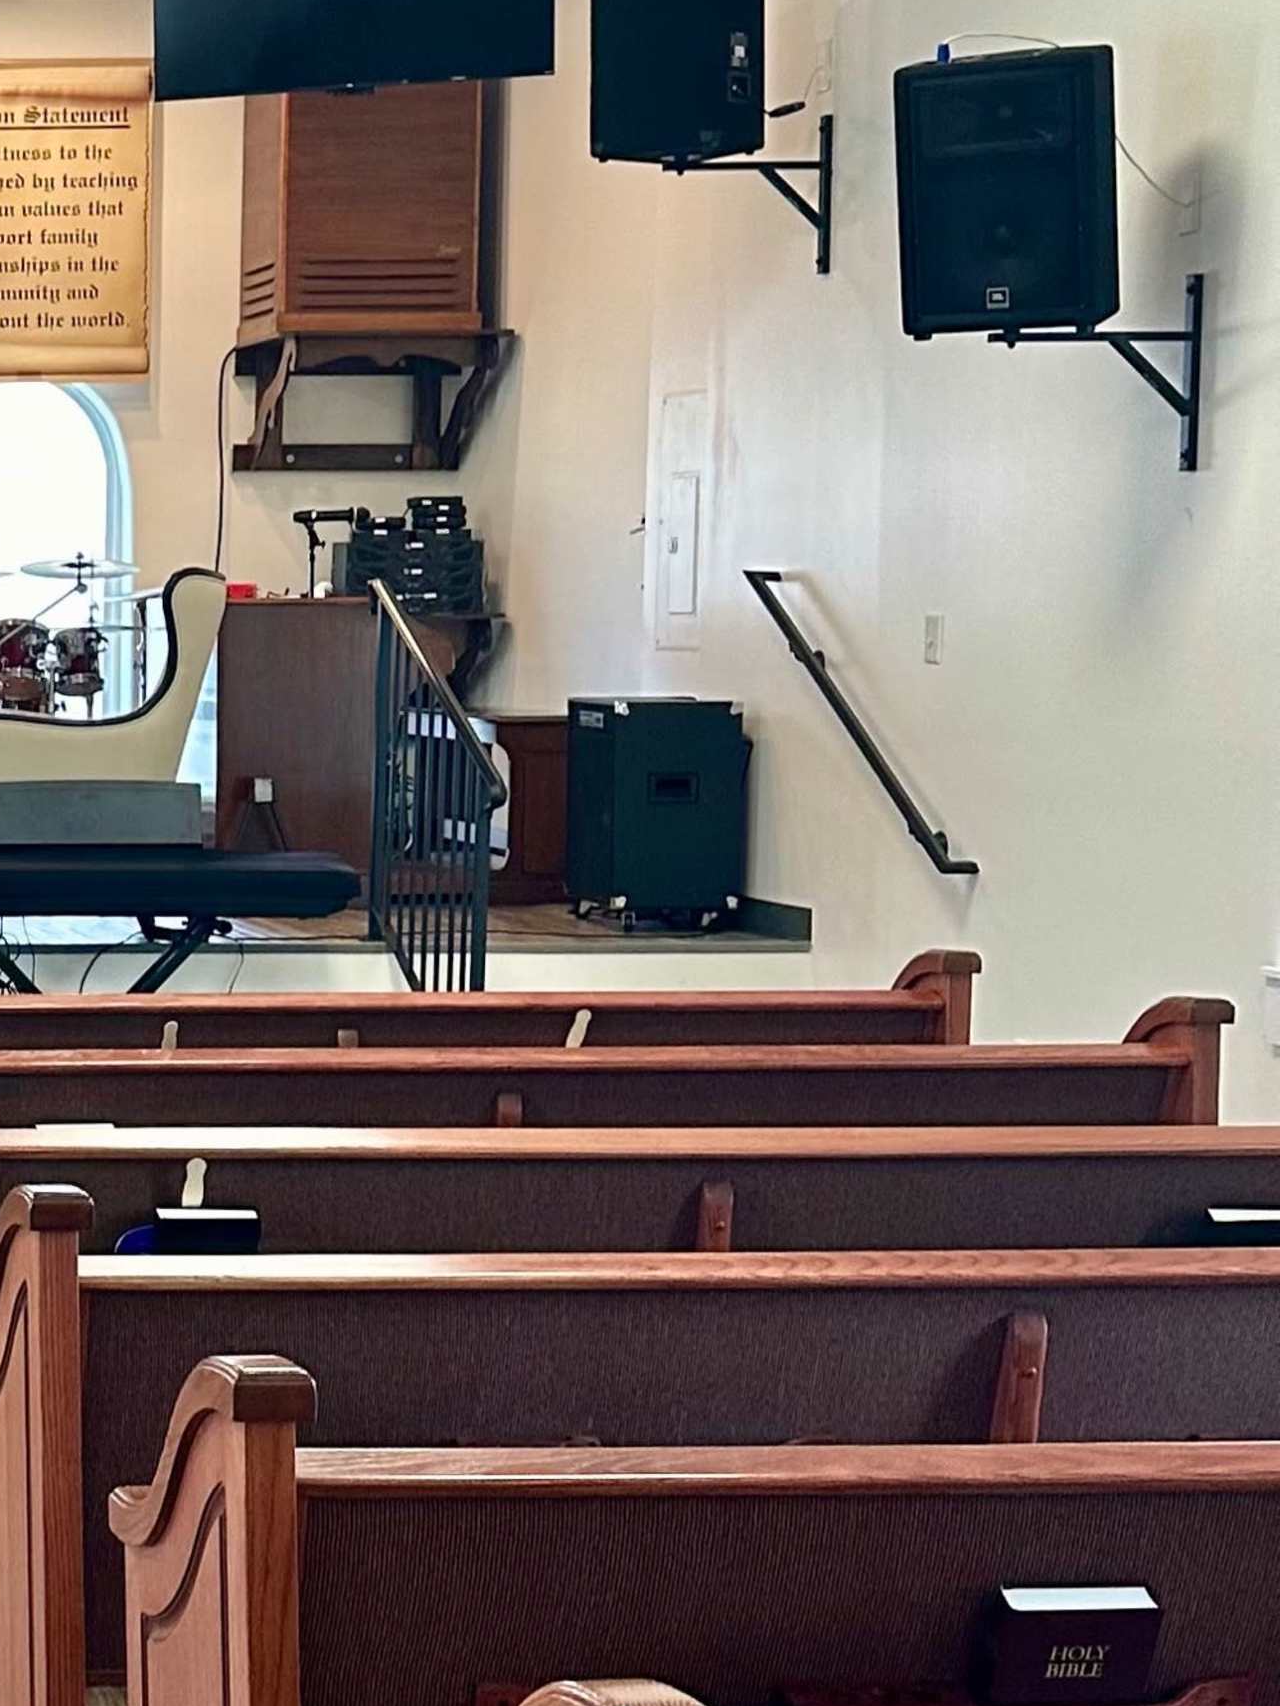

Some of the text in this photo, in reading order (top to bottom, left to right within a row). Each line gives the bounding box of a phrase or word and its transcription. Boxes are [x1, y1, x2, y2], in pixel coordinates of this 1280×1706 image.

[23, 106, 129, 124] Statement
[60, 146, 77, 161] to
[85, 144, 112, 162] the
[32, 174, 55, 192] by
[62, 173, 138, 191] teaching
[22, 203, 80, 217] values
[88, 201, 123, 218] that
[40, 228, 98, 247] family
[68, 256, 84, 272] in
[91, 257, 119, 274] the
[67, 285, 99, 300] and
[37, 313, 64, 331] the
[1049, 1645, 1111, 1662] HOLY
[1044, 1662, 1105, 1679] BIBLE
